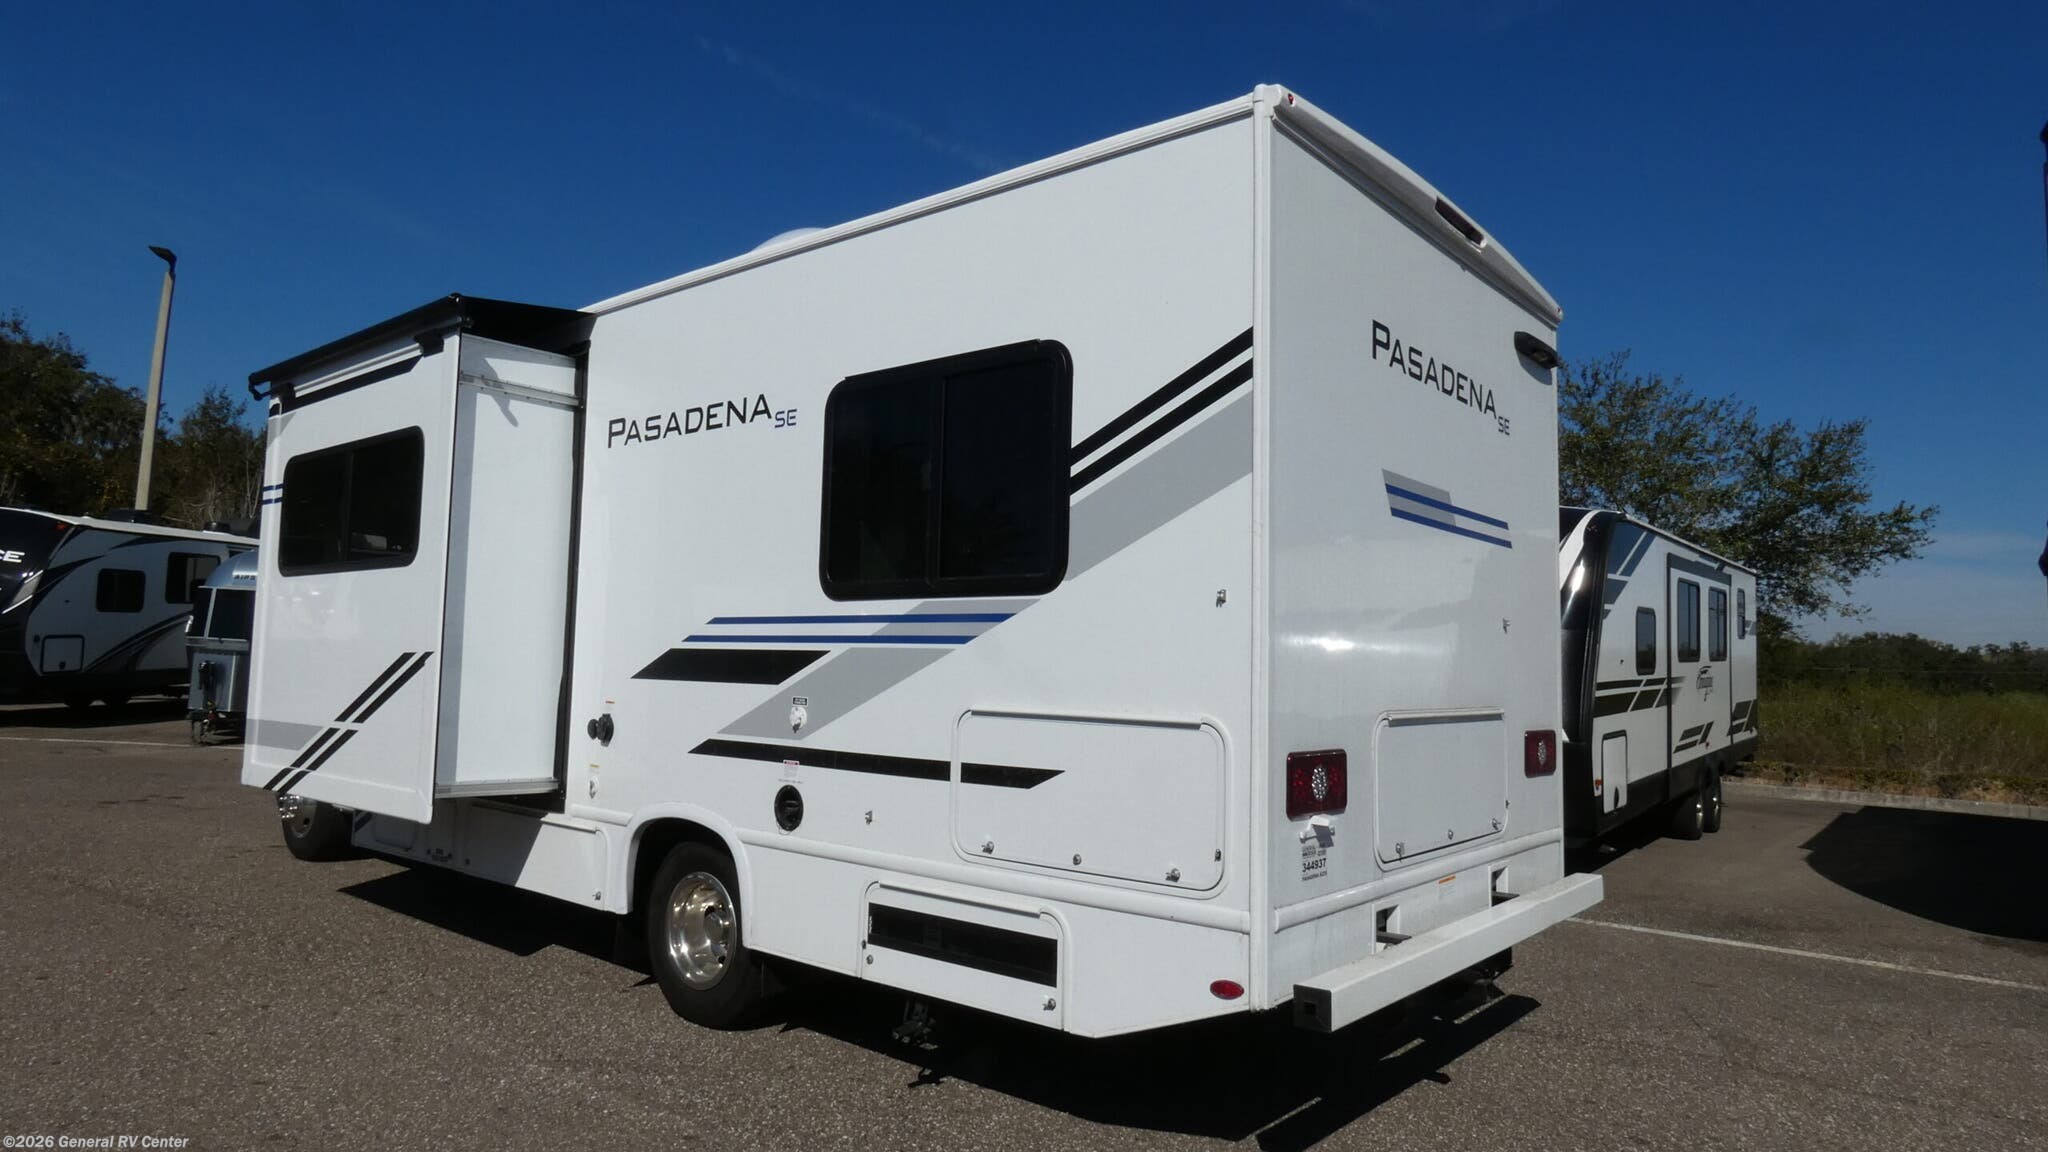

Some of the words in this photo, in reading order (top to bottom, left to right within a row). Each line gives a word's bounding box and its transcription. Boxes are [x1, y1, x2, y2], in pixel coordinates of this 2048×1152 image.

[1371, 319, 1497, 420] PASADENA
[1497, 415, 1511, 436] SE
[607, 393, 773, 449] PASADENA
[774, 408, 798, 429] SE
[0, 548, 26, 563] E
[1301, 857, 1327, 873] 344937
